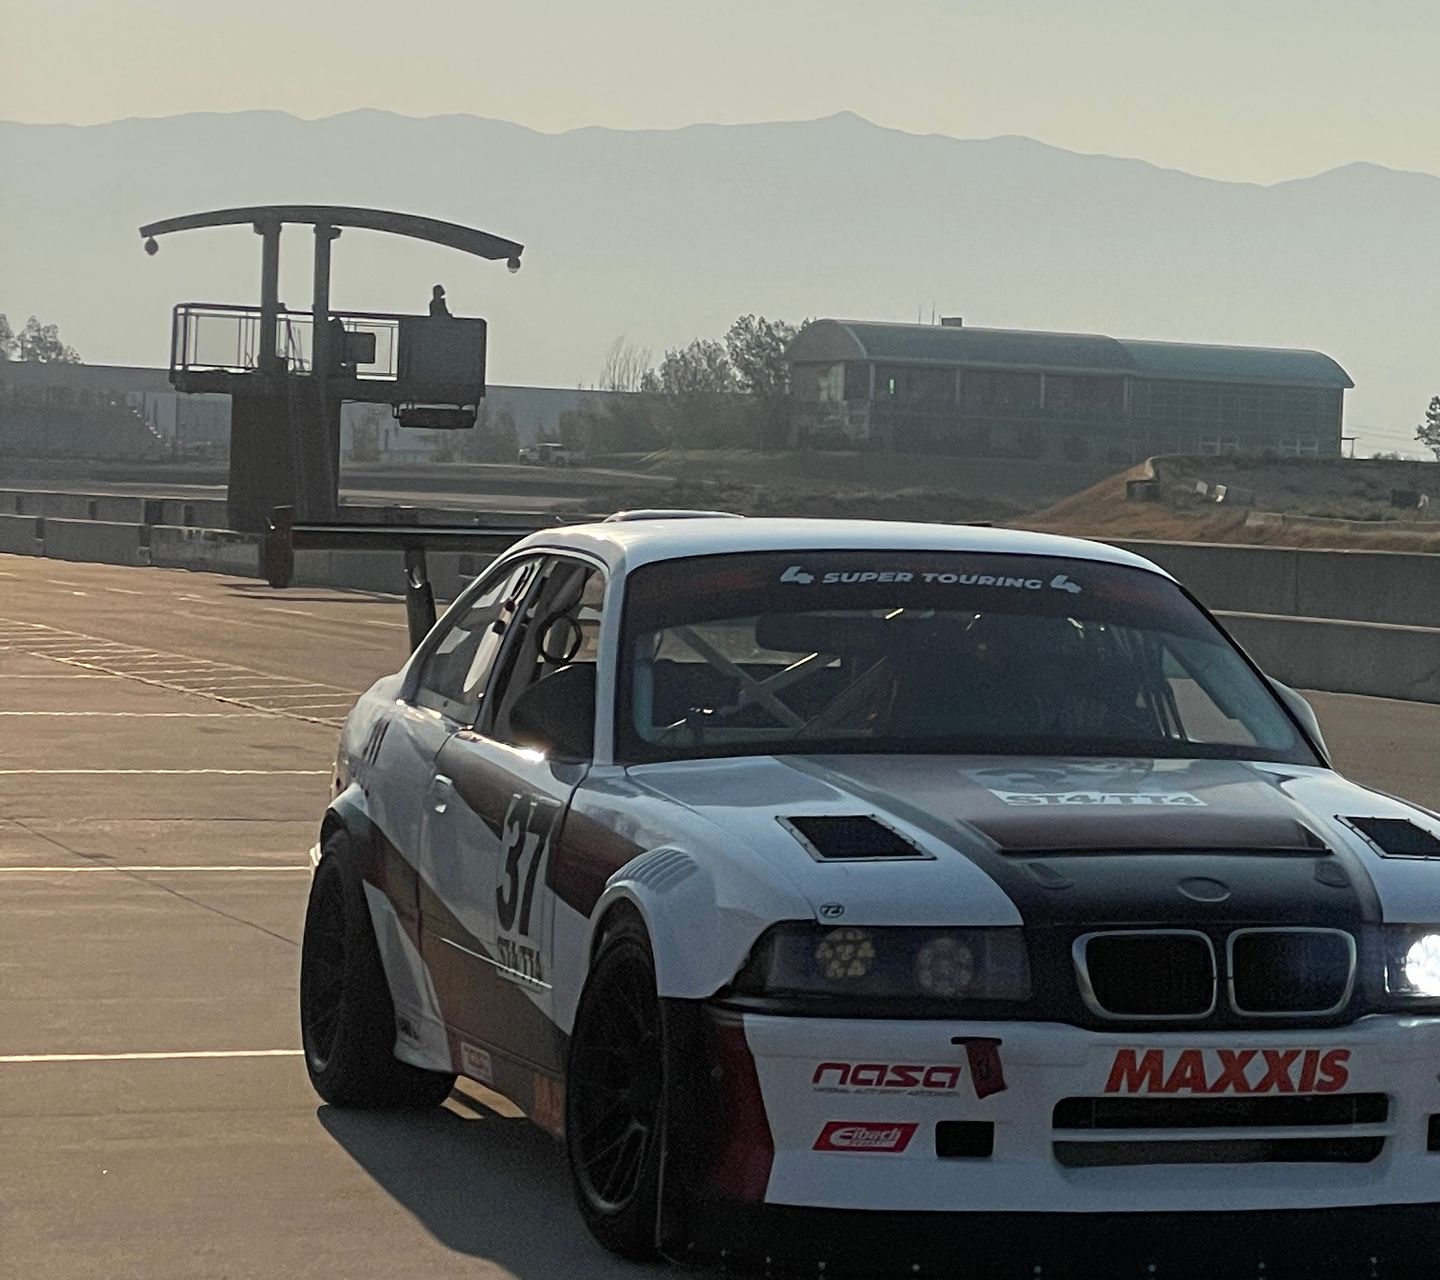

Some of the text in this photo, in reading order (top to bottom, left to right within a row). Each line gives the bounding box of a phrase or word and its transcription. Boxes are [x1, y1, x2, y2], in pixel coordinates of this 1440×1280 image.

[822, 571, 913, 584] SUPER
[921, 572, 1043, 591] TOURING
[496, 796, 556, 936] 37
[812, 1062, 961, 1088] nasa
[1104, 1049, 1351, 1094] MAXXIS
